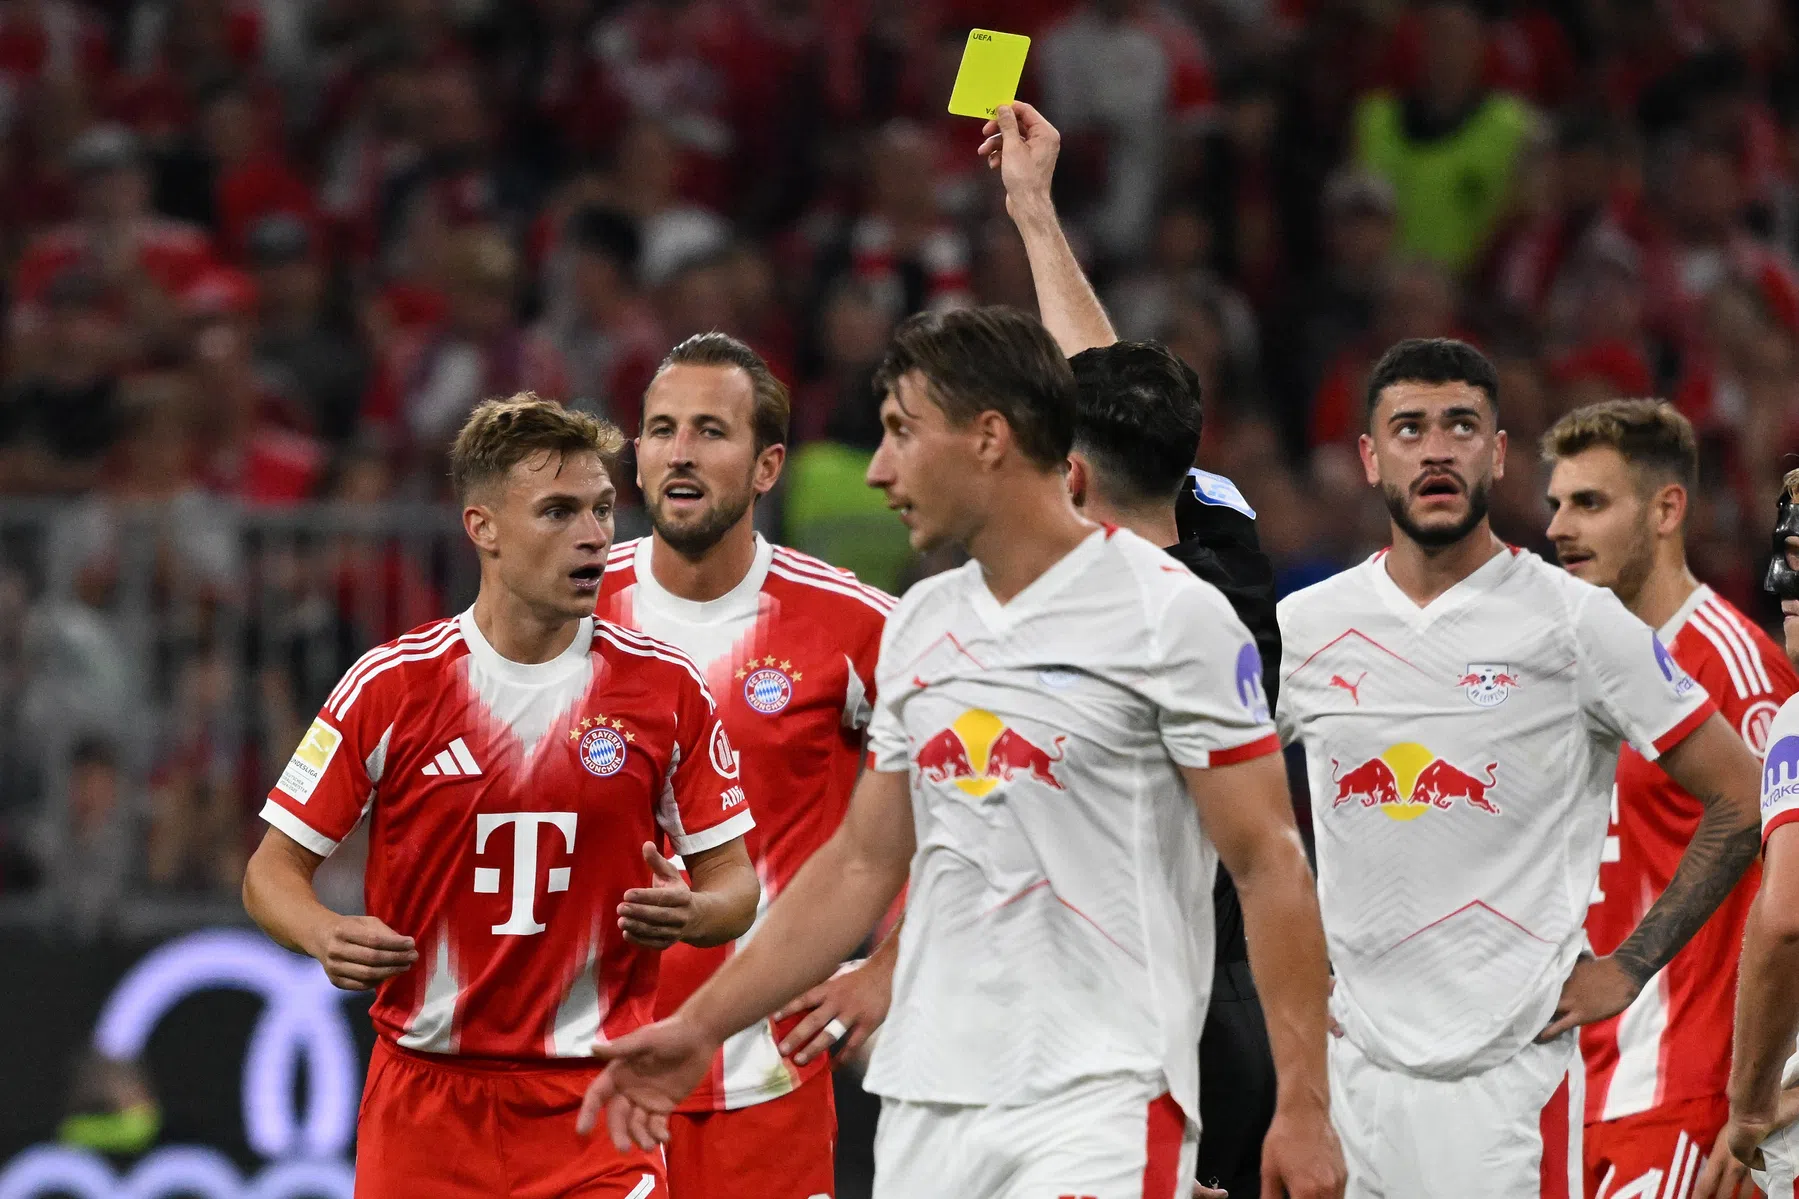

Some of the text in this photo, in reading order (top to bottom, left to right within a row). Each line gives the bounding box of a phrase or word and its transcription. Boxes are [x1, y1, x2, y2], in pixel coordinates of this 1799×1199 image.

[973, 33, 992, 42] UEFA
[748, 672, 788, 689] FC BAYERN
[583, 731, 622, 749] FC BAYERN
